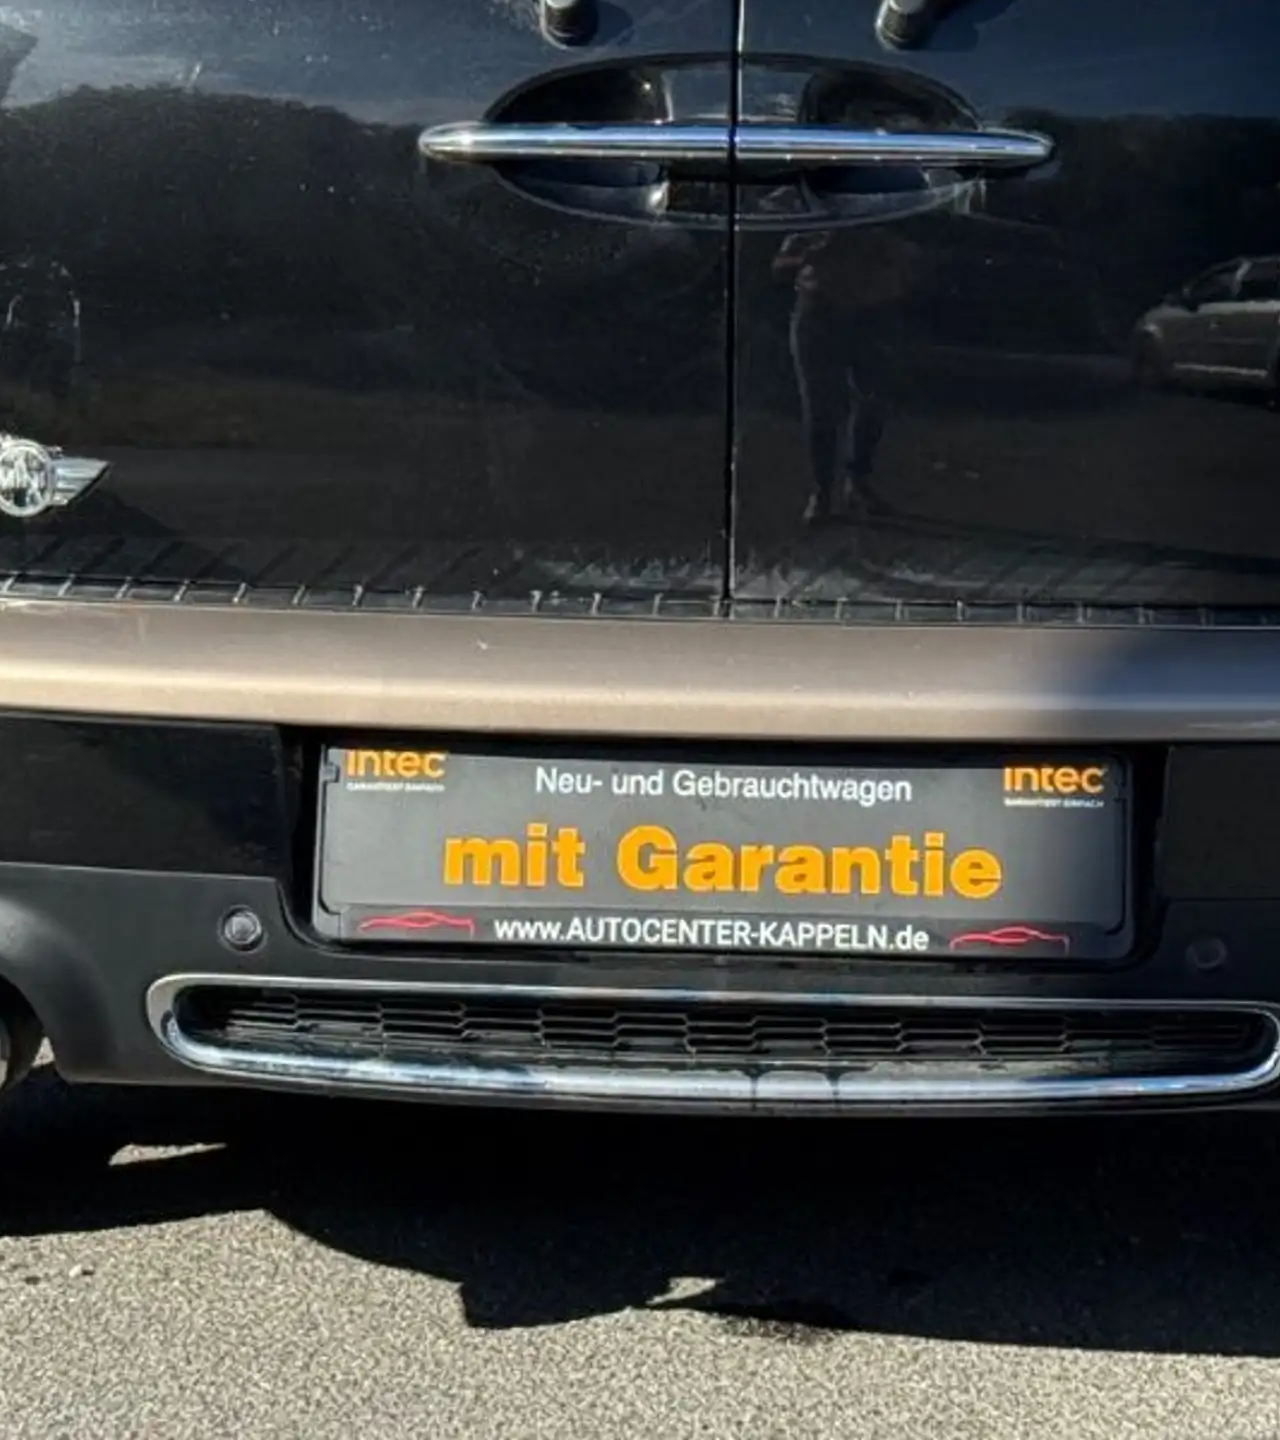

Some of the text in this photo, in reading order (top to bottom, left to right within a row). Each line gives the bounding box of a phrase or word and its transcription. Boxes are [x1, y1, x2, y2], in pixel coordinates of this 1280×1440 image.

[346, 750, 1106, 804] intec Neu- und Gebrauchtwagen intec
[443, 823, 1003, 898] mit Garantie
[494, 915, 928, 952] www.AUTOCENTER-KAPPELN.de
